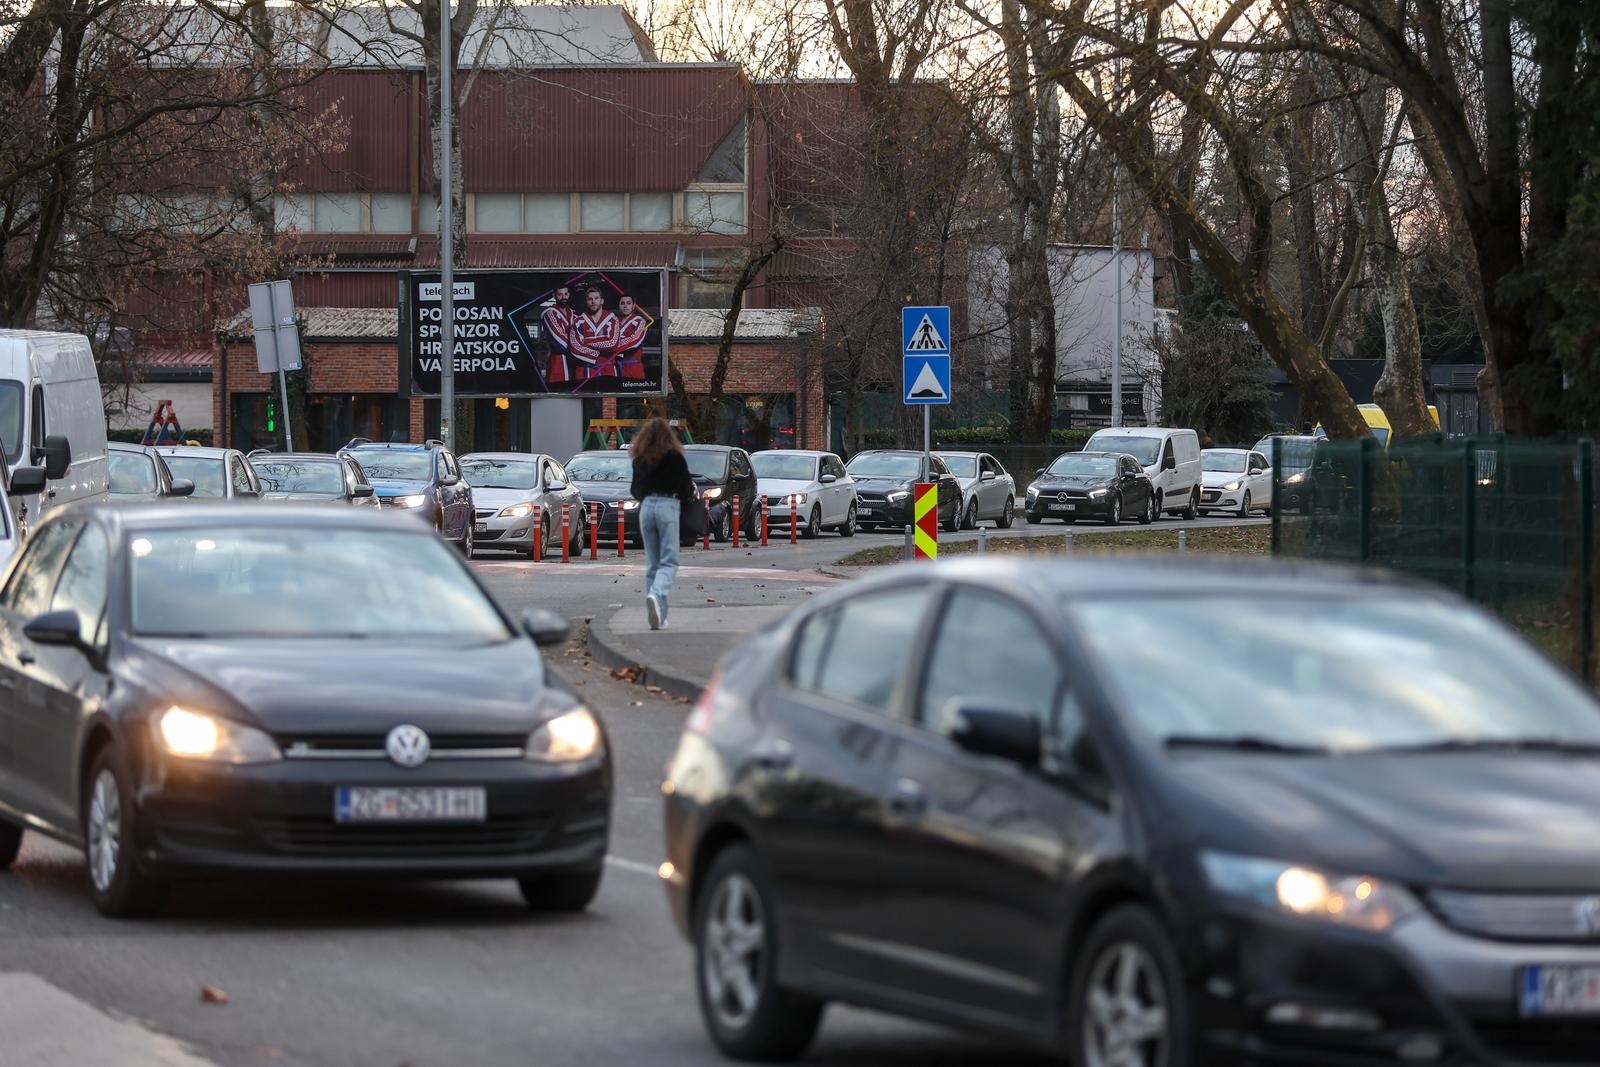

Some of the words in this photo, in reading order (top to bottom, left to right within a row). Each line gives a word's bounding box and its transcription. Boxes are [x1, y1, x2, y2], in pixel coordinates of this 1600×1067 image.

[425, 286, 470, 296] teleach
[419, 306, 503, 321] POOSAN
[419, 323, 500, 338] SPNZOR
[419, 340, 520, 355] HRATSKOG
[418, 357, 516, 372] VAERPOLA
